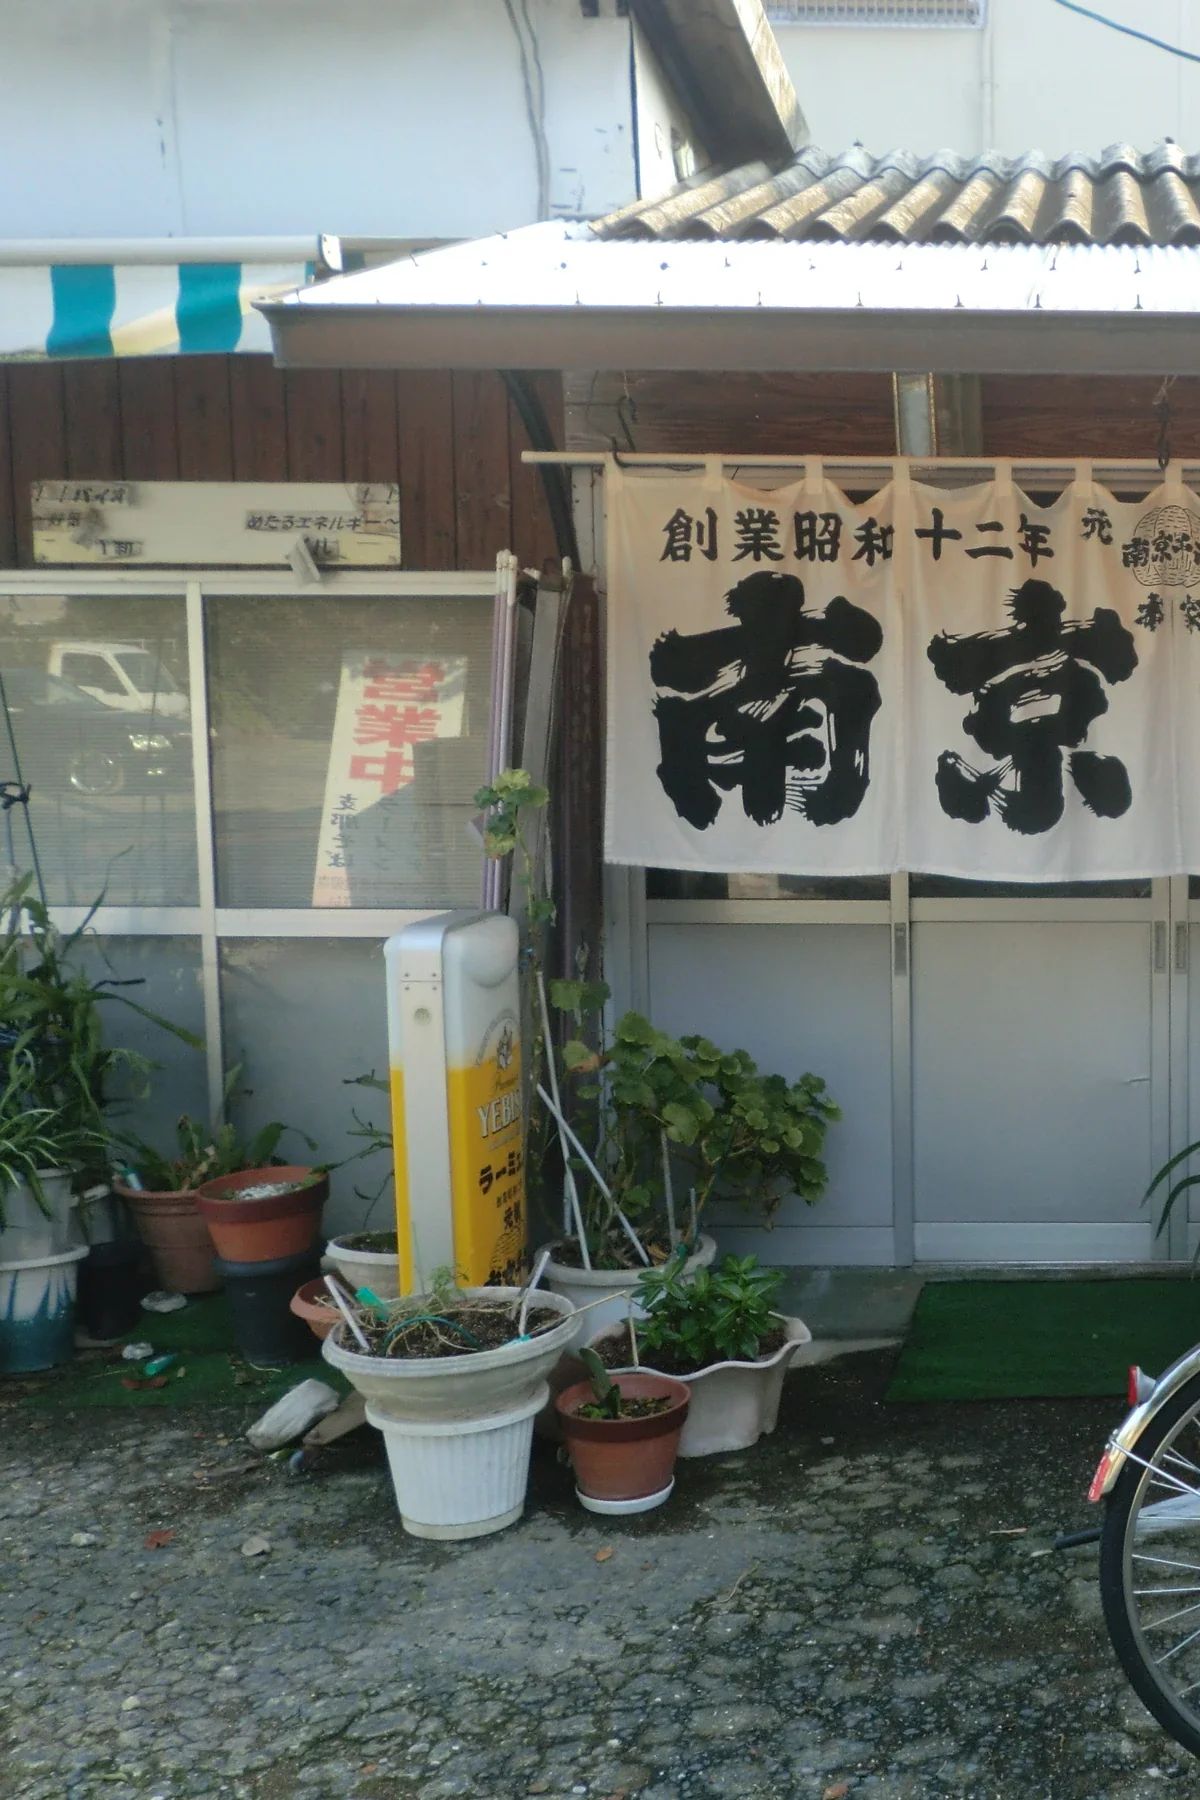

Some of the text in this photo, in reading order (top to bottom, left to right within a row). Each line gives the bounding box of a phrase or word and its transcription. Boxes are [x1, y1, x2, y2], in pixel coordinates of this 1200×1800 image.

[660, 506, 1055, 568] 創業昭和十二年
